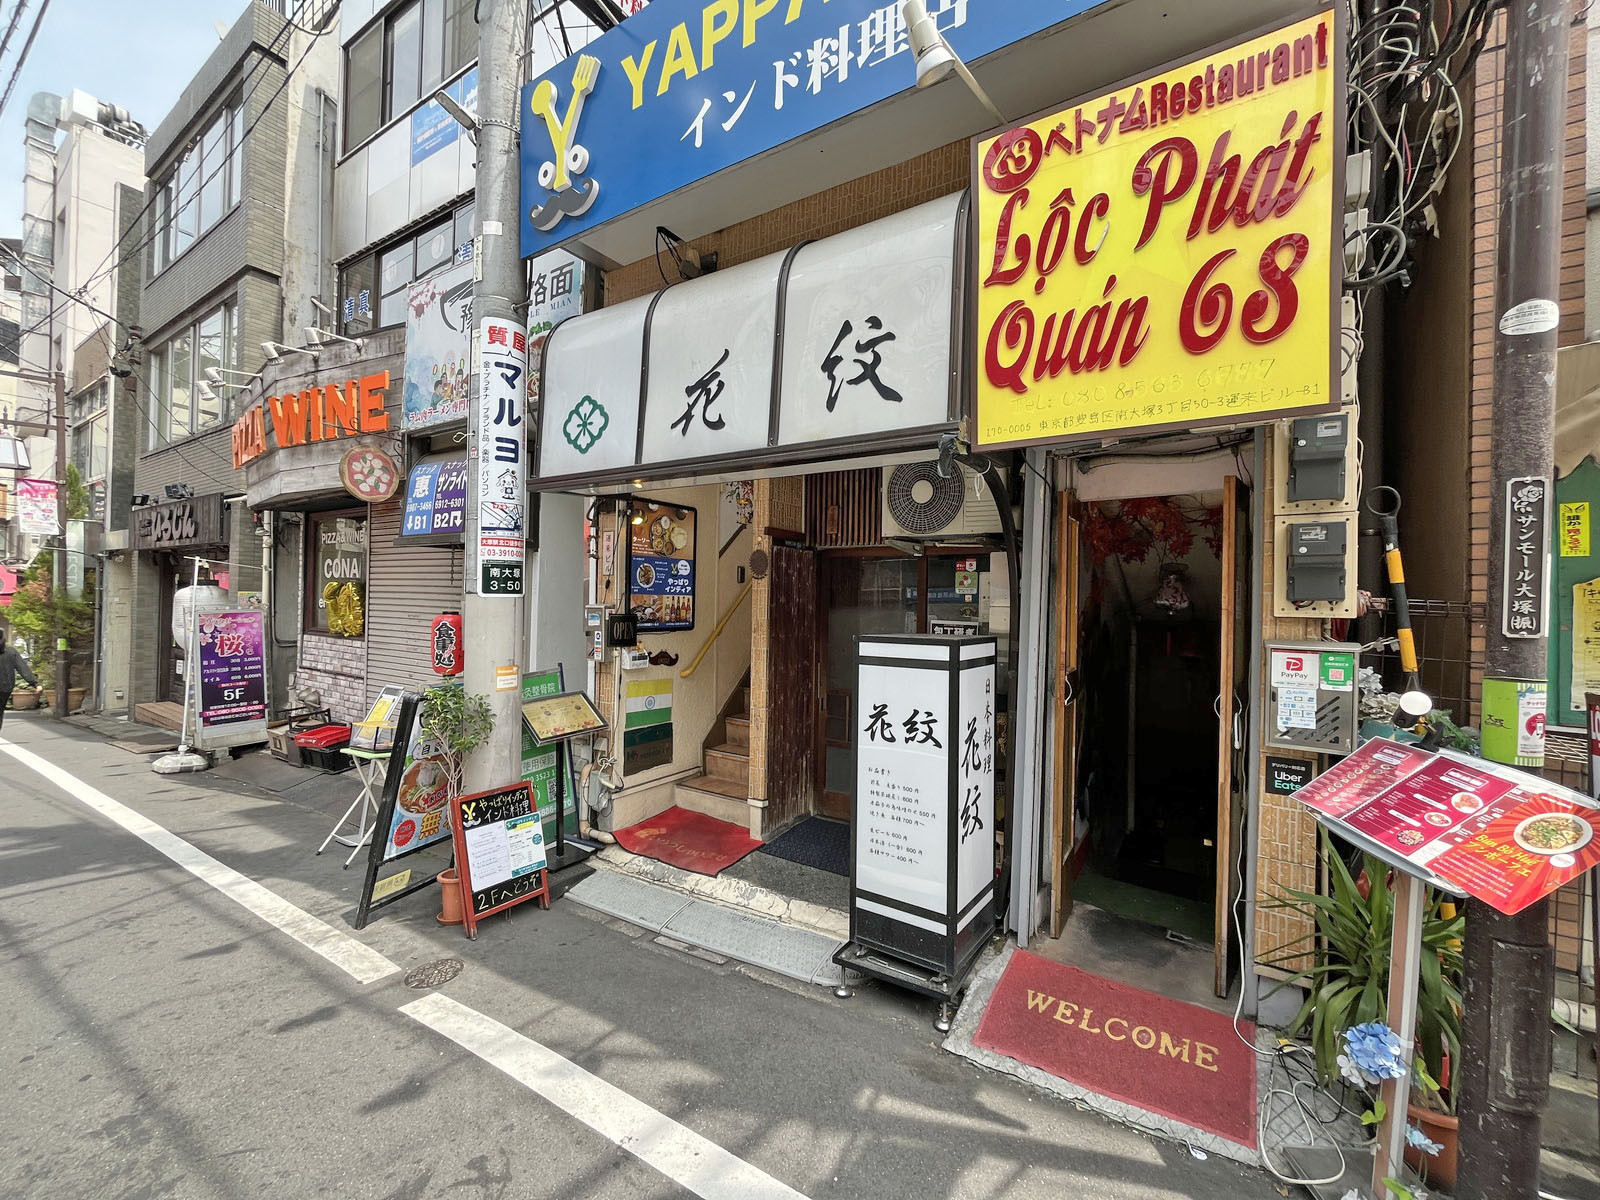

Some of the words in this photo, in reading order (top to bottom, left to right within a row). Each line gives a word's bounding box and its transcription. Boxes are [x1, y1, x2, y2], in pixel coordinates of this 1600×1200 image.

[620, 0, 802, 110] YAPP
[1131, 110, 1324, 252] Phát
[984, 274, 1151, 393] Quán
[1179, 232, 1310, 356] 68
[487, 325, 527, 354] 質屋
[670, 314, 904, 437] 花紋
[231, 404, 267, 471] PIZZA
[267, 369, 391, 449] WINE
[408, 398, 469, 424] ラム肉ラーメン専門
[493, 361, 522, 464] マルヨ
[414, 515, 427, 530] B1
[433, 513, 449, 529] B2
[321, 530, 365, 545] PIZZA&WINE
[324, 558, 361, 579] CONA
[489, 580, 521, 592] 3-50
[665, 586, 692, 594] インディア
[216, 633, 244, 657] 桜
[1281, 671, 1308, 680] PayPay
[223, 687, 245, 701] 5F
[520, 683, 557, 699] 灸整骨院
[863, 703, 943, 749] 花紋
[982, 678, 993, 775] 日本料理
[960, 716, 984, 845] 花紋
[1274, 770, 1303, 782] Uber
[1274, 780, 1302, 791] Eats
[484, 800, 531, 823] インド料理
[477, 873, 540, 911] 2Fへどうぞ
[1026, 988, 1221, 1073] WELCOME
